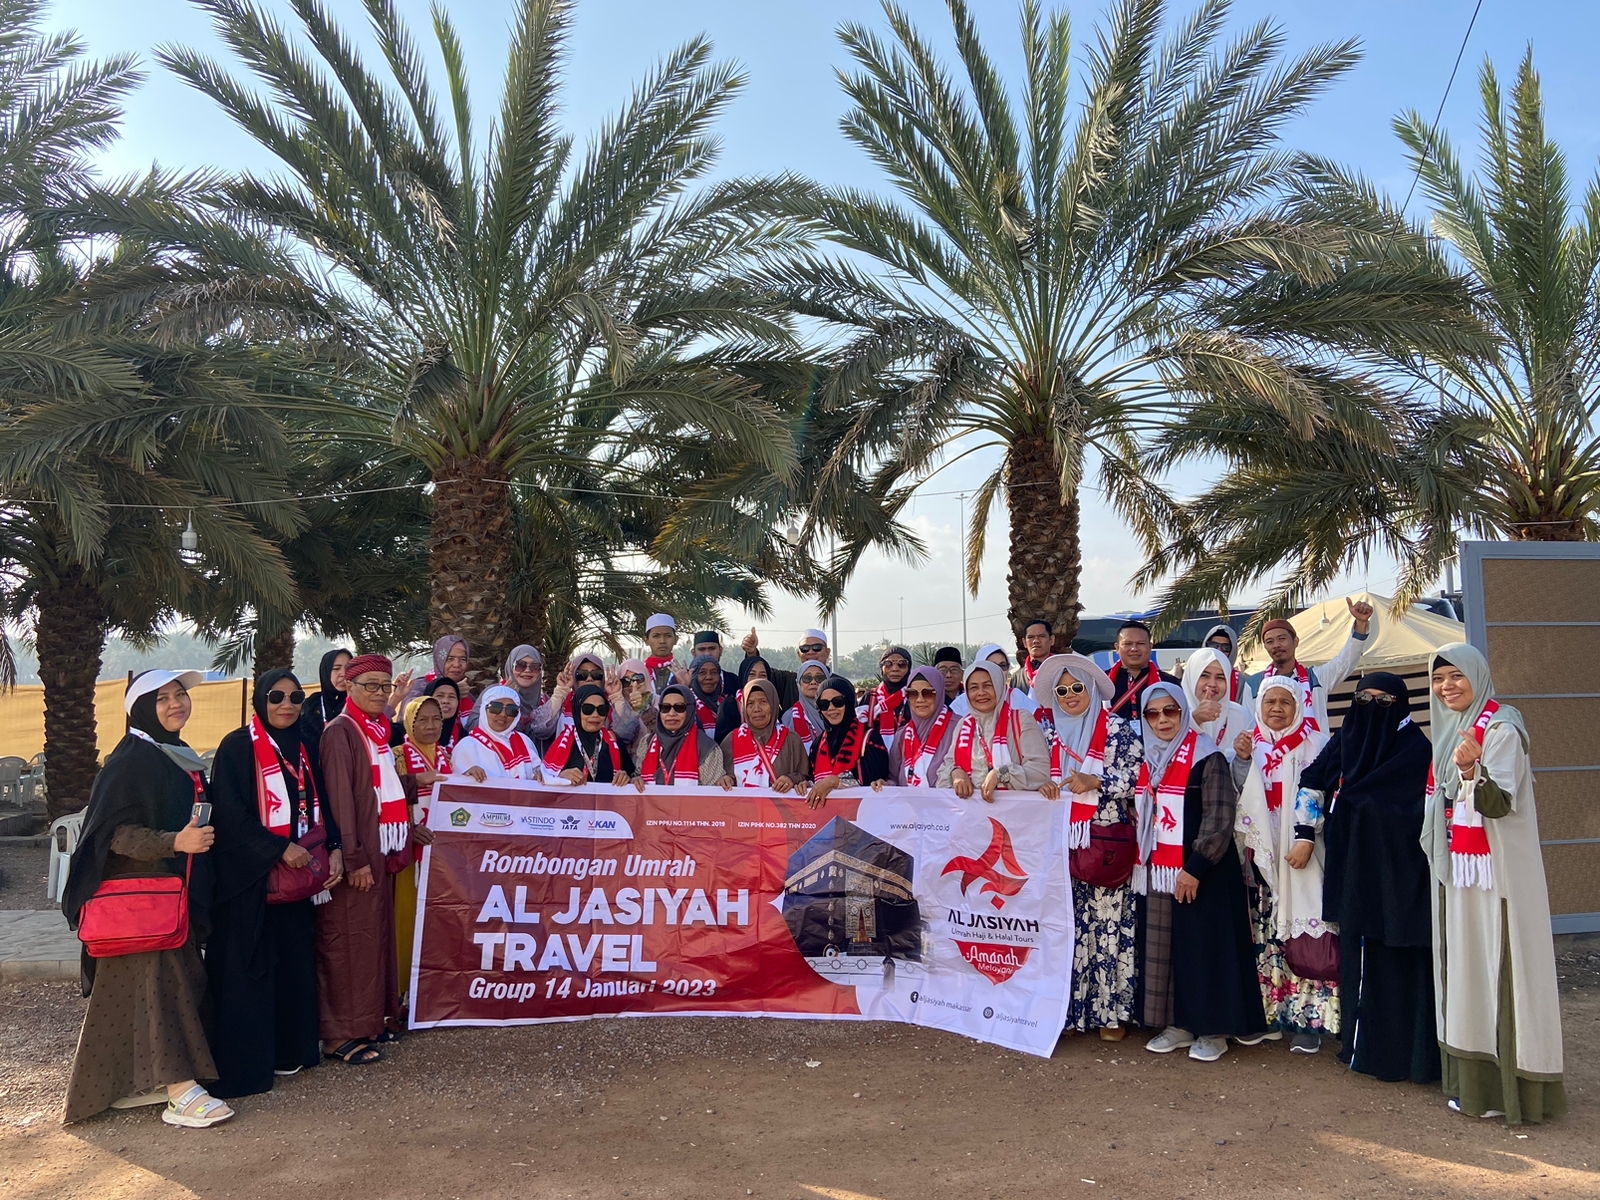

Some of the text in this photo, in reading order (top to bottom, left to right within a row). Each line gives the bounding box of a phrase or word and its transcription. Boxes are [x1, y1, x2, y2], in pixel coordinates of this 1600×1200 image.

[523, 816, 555, 825] ASTINDO
[595, 820, 616, 828] KAN
[479, 850, 696, 879] Rombongan Umrah
[476, 884, 749, 926] AL JASIYAH
[951, 927, 972, 938] Umrah
[972, 930, 986, 941] Haji
[994, 933, 1013, 941] Halal
[1014, 934, 1034, 943] Tours
[473, 932, 657, 973] TRAVEL
[469, 977, 717, 1003] Group 14 Januari 2023
